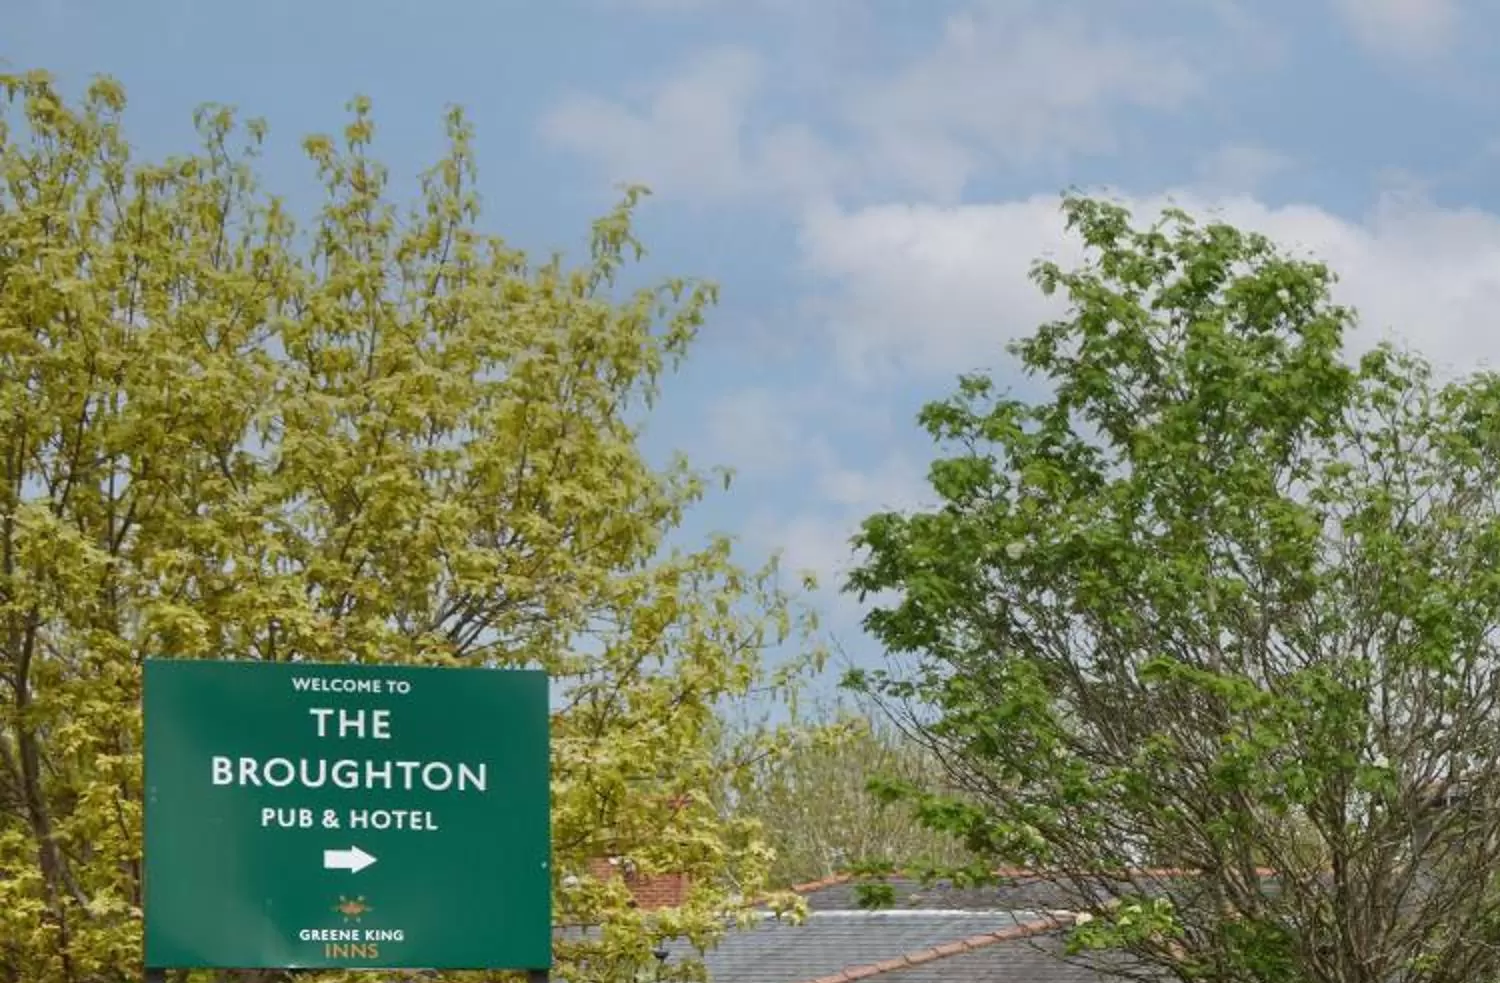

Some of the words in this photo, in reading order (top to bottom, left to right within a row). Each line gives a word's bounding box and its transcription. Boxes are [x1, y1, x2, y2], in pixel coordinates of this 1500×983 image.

[291, 678, 381, 694] WELCOME
[387, 680, 411, 694] TO
[310, 708, 391, 739] THE
[212, 756, 487, 792] BROUGHTON
[262, 808, 313, 829] PUB
[322, 809, 340, 829] &
[350, 810, 438, 831] HOTEL
[299, 929, 359, 942] GREENE
[366, 930, 404, 942] KING
[325, 943, 379, 959] INNS
